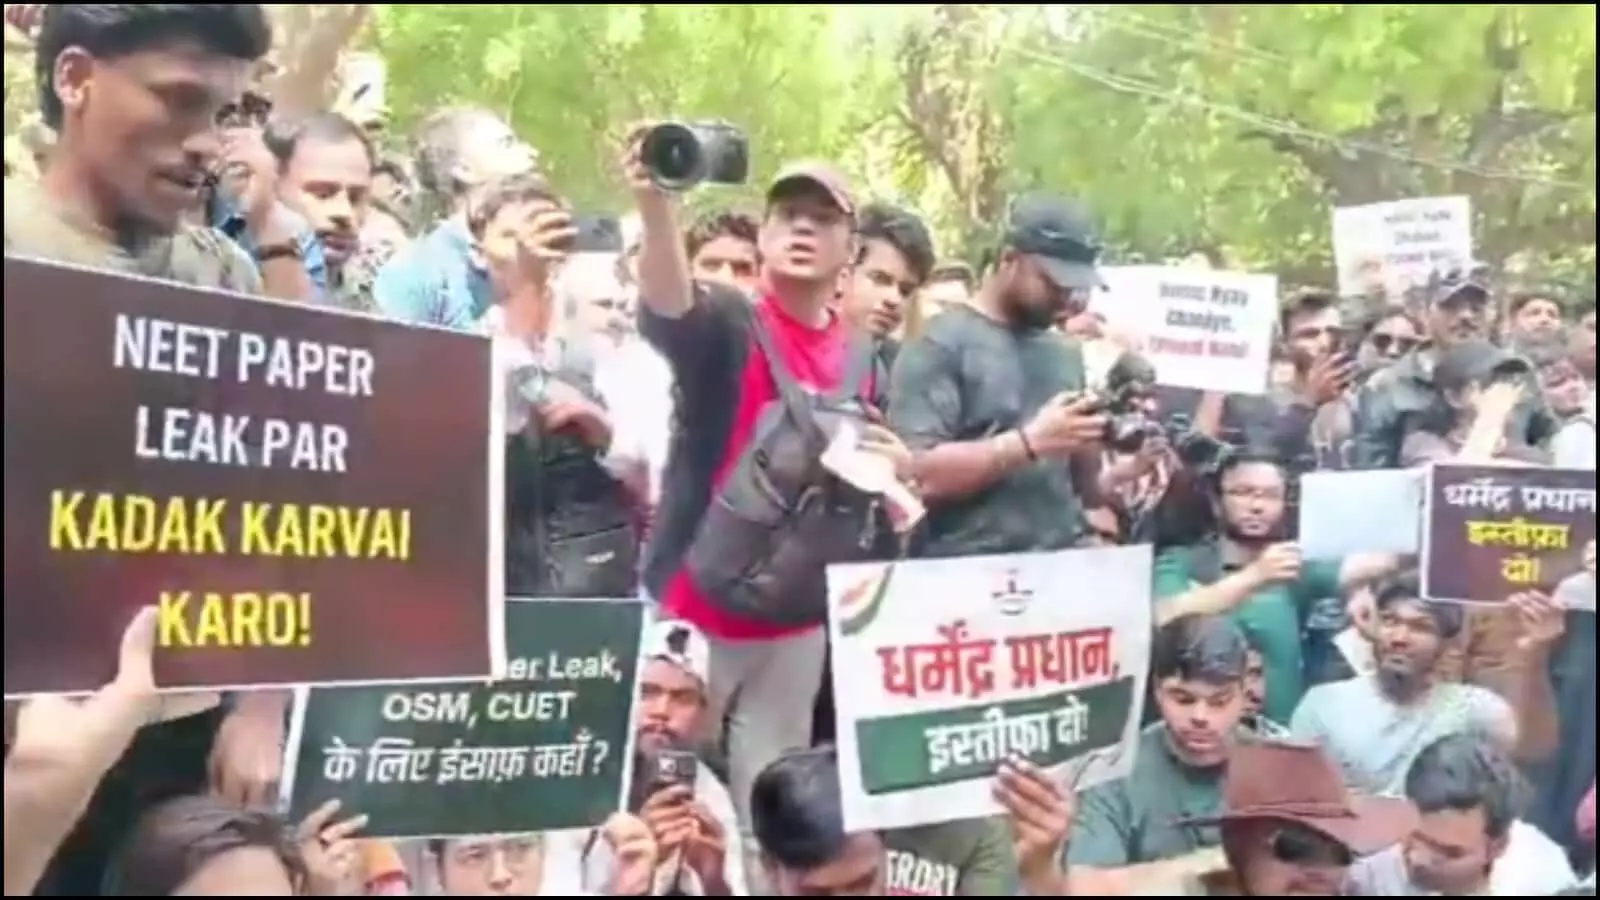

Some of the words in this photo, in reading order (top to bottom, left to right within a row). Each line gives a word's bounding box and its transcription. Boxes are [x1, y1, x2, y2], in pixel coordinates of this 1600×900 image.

[113, 313, 229, 379] NEET
[237, 332, 375, 397] PAPER
[135, 405, 249, 467] LEAK
[261, 418, 348, 473] PAR
[50, 489, 228, 555] KADAK
[240, 501, 412, 560] KARVAI
[159, 590, 312, 648] KARO!
[548, 649, 623, 684] Leak,
[876, 619, 997, 699] धर्मेंद्र
[1004, 627, 1121, 689] प्रधान,
[383, 692, 478, 729] OSM,
[487, 691, 578, 721] CUET
[322, 735, 362, 782] के
[365, 737, 434, 783] लिए
[436, 739, 530, 785] इंसाफ़
